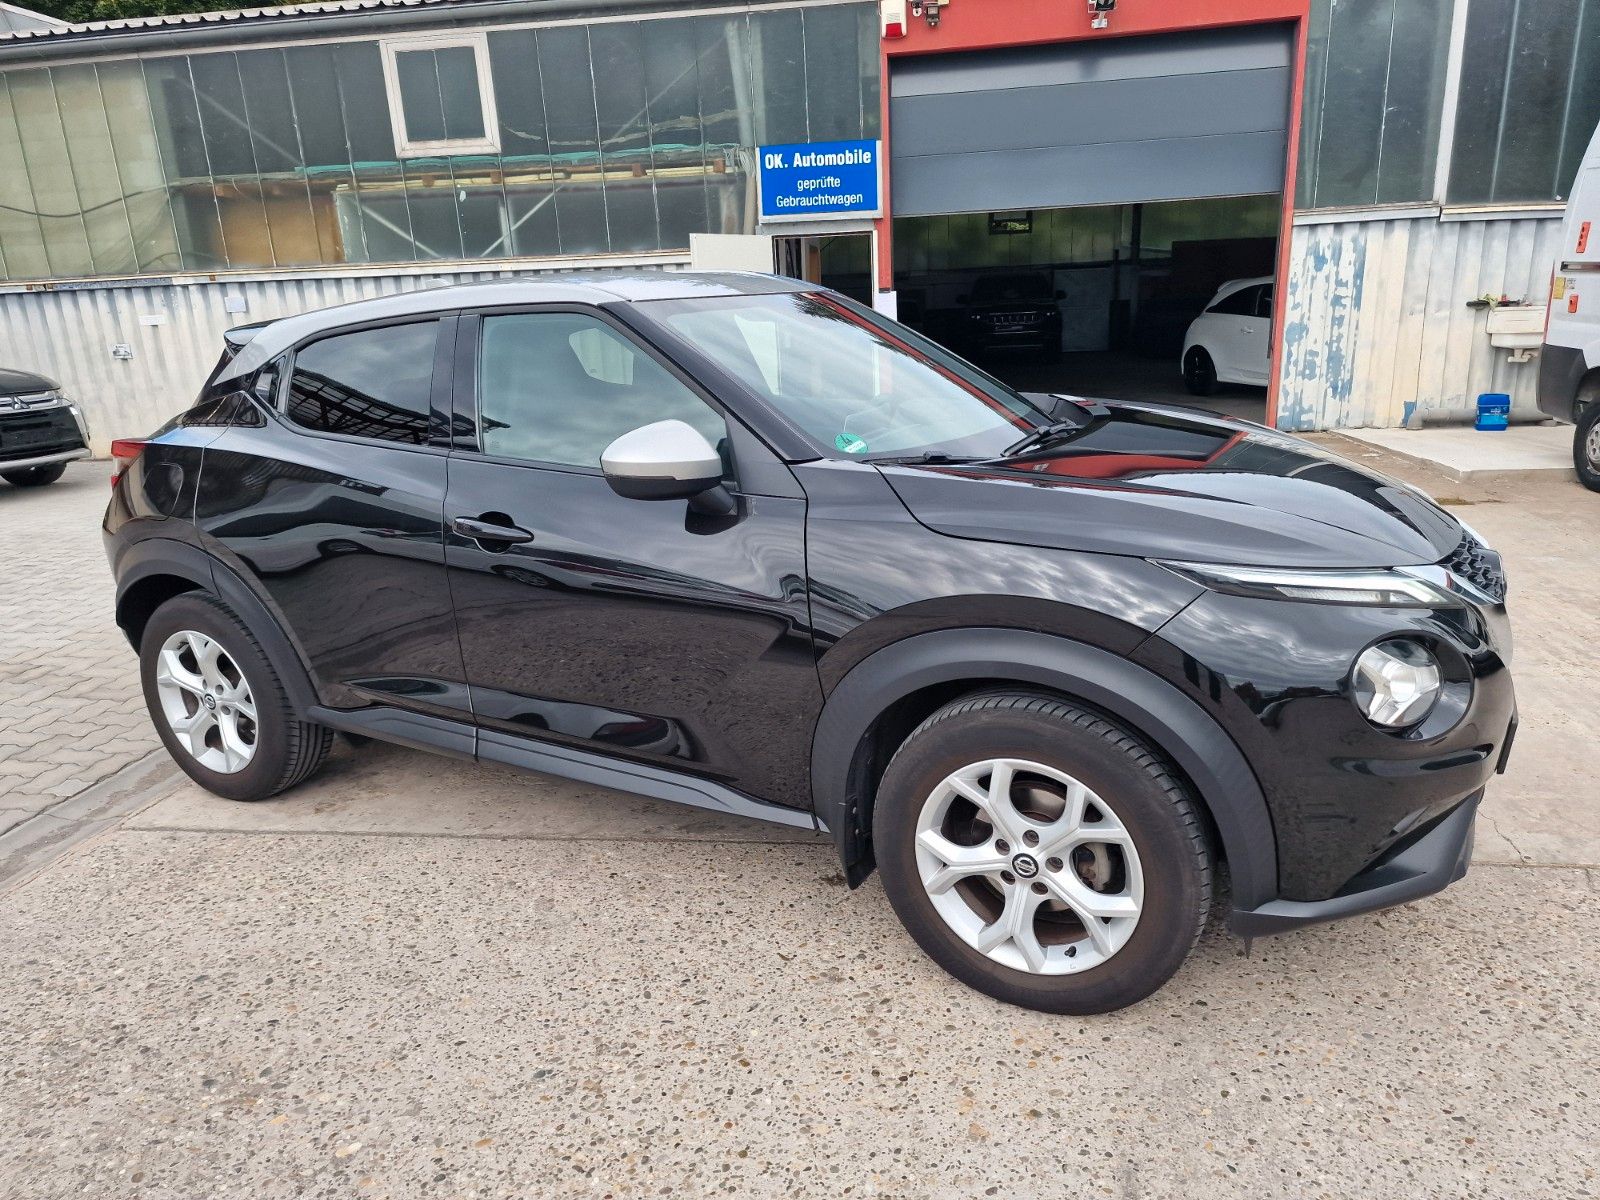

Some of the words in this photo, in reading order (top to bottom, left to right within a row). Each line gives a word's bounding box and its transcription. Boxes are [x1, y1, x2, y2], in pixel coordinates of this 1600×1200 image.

[765, 153, 788, 169] OK.
[793, 149, 872, 168] Automobile
[797, 176, 841, 191] geprüfte
[776, 193, 863, 207] Gebrauchtwagen
